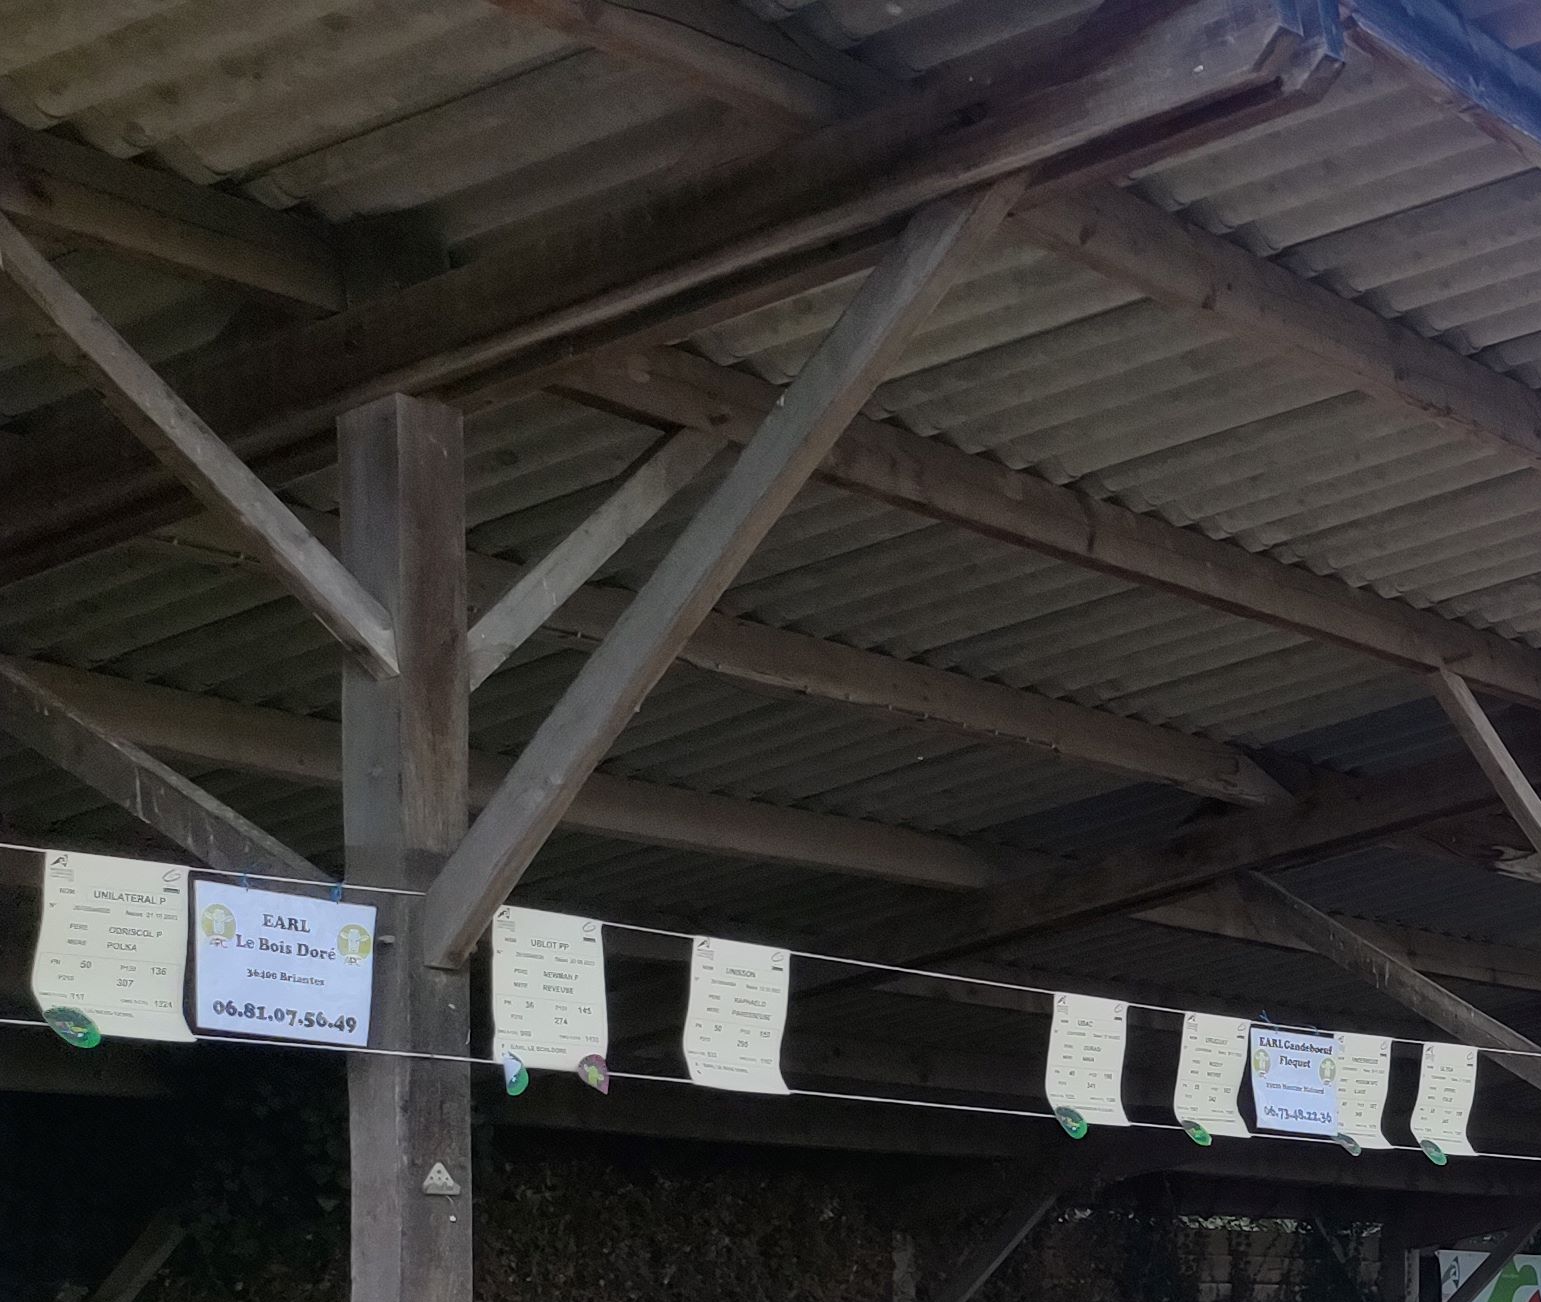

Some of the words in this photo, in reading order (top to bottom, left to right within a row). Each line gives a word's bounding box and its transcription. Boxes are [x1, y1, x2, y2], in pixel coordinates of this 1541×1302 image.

[94, 890, 156, 905] UNILATERAL
[160, 897, 167, 905] P
[262, 914, 311, 934] EARL
[236, 934, 255, 950] Le
[258, 938, 293, 955] Bois
[296, 943, 337, 961] Doré
[151, 967, 167, 976] 136
[212, 1000, 358, 1034] 06.81.07.56.49
[1259, 1036, 1283, 1049] EARL
